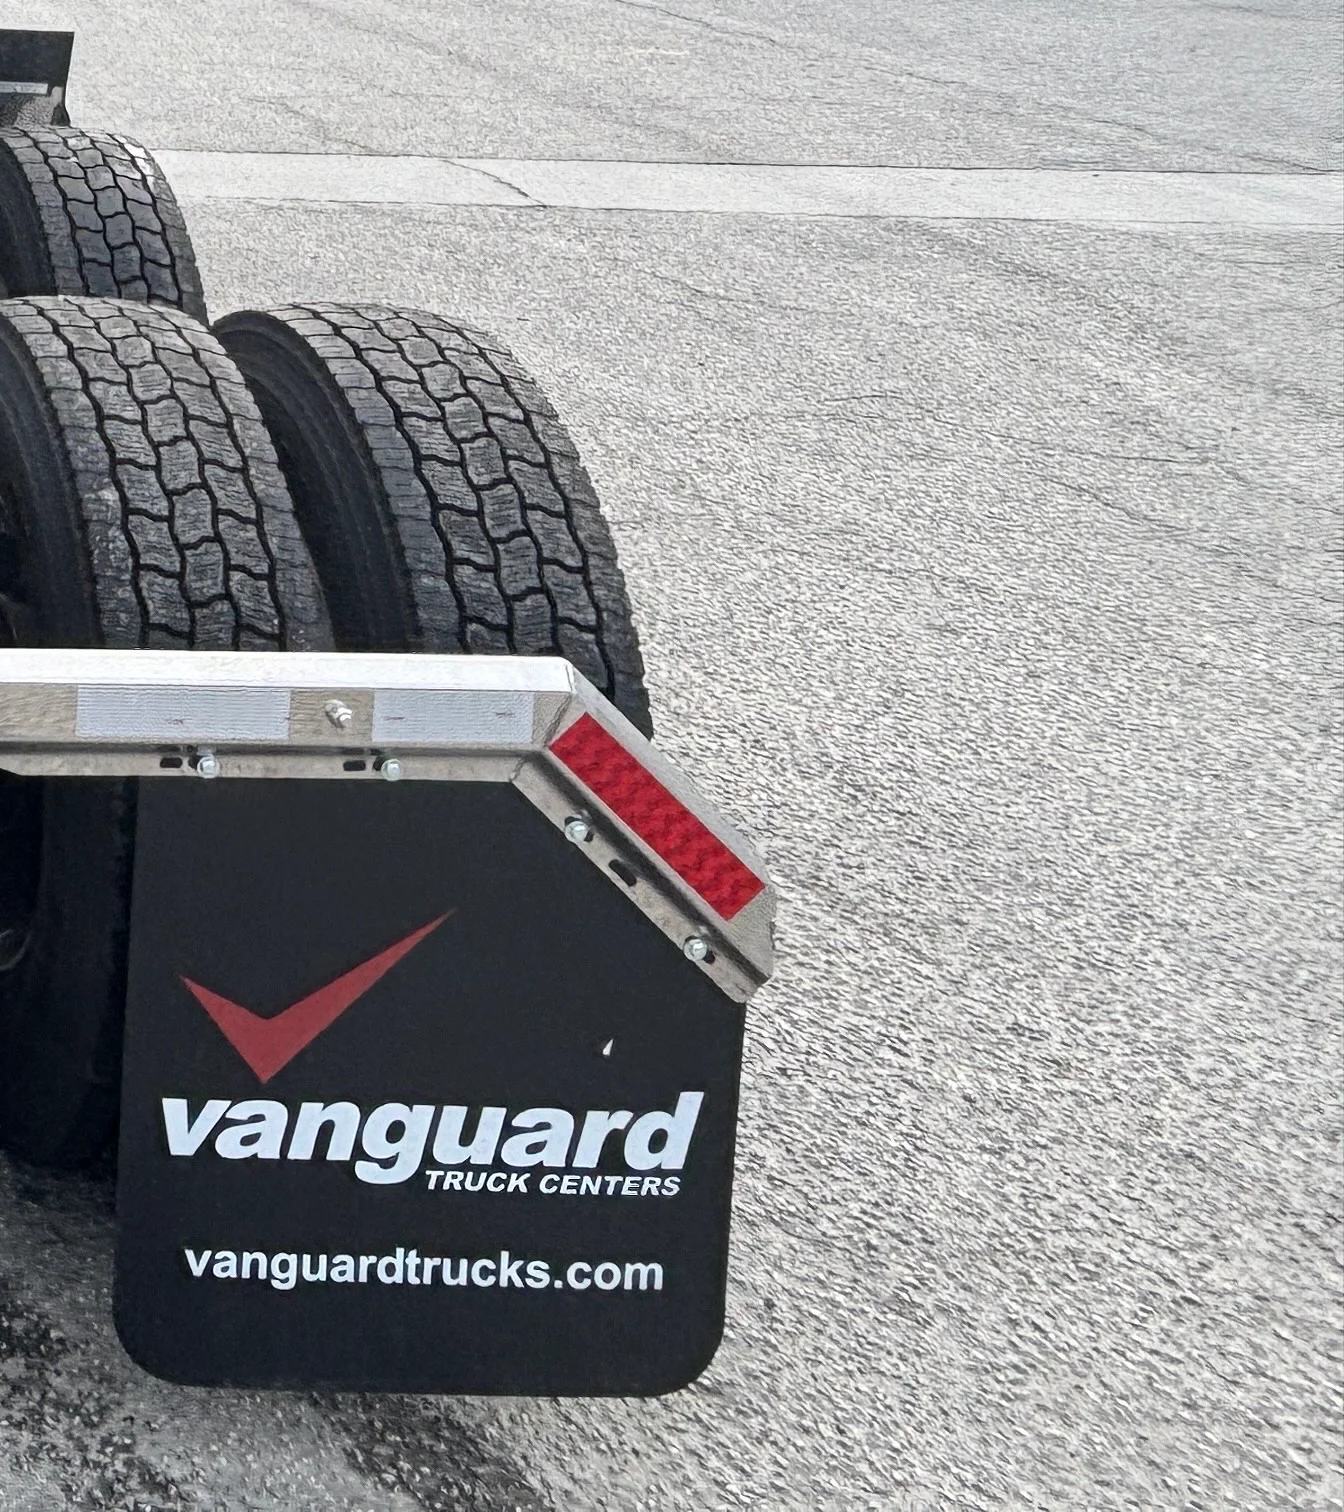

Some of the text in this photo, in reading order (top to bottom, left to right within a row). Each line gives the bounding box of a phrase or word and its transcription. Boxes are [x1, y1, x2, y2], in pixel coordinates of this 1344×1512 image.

[161, 1091, 705, 1185] vanguard
[425, 1169, 682, 1197] TRUCK CENTERS
[184, 1247, 664, 1290] vanguardtrucks.com
